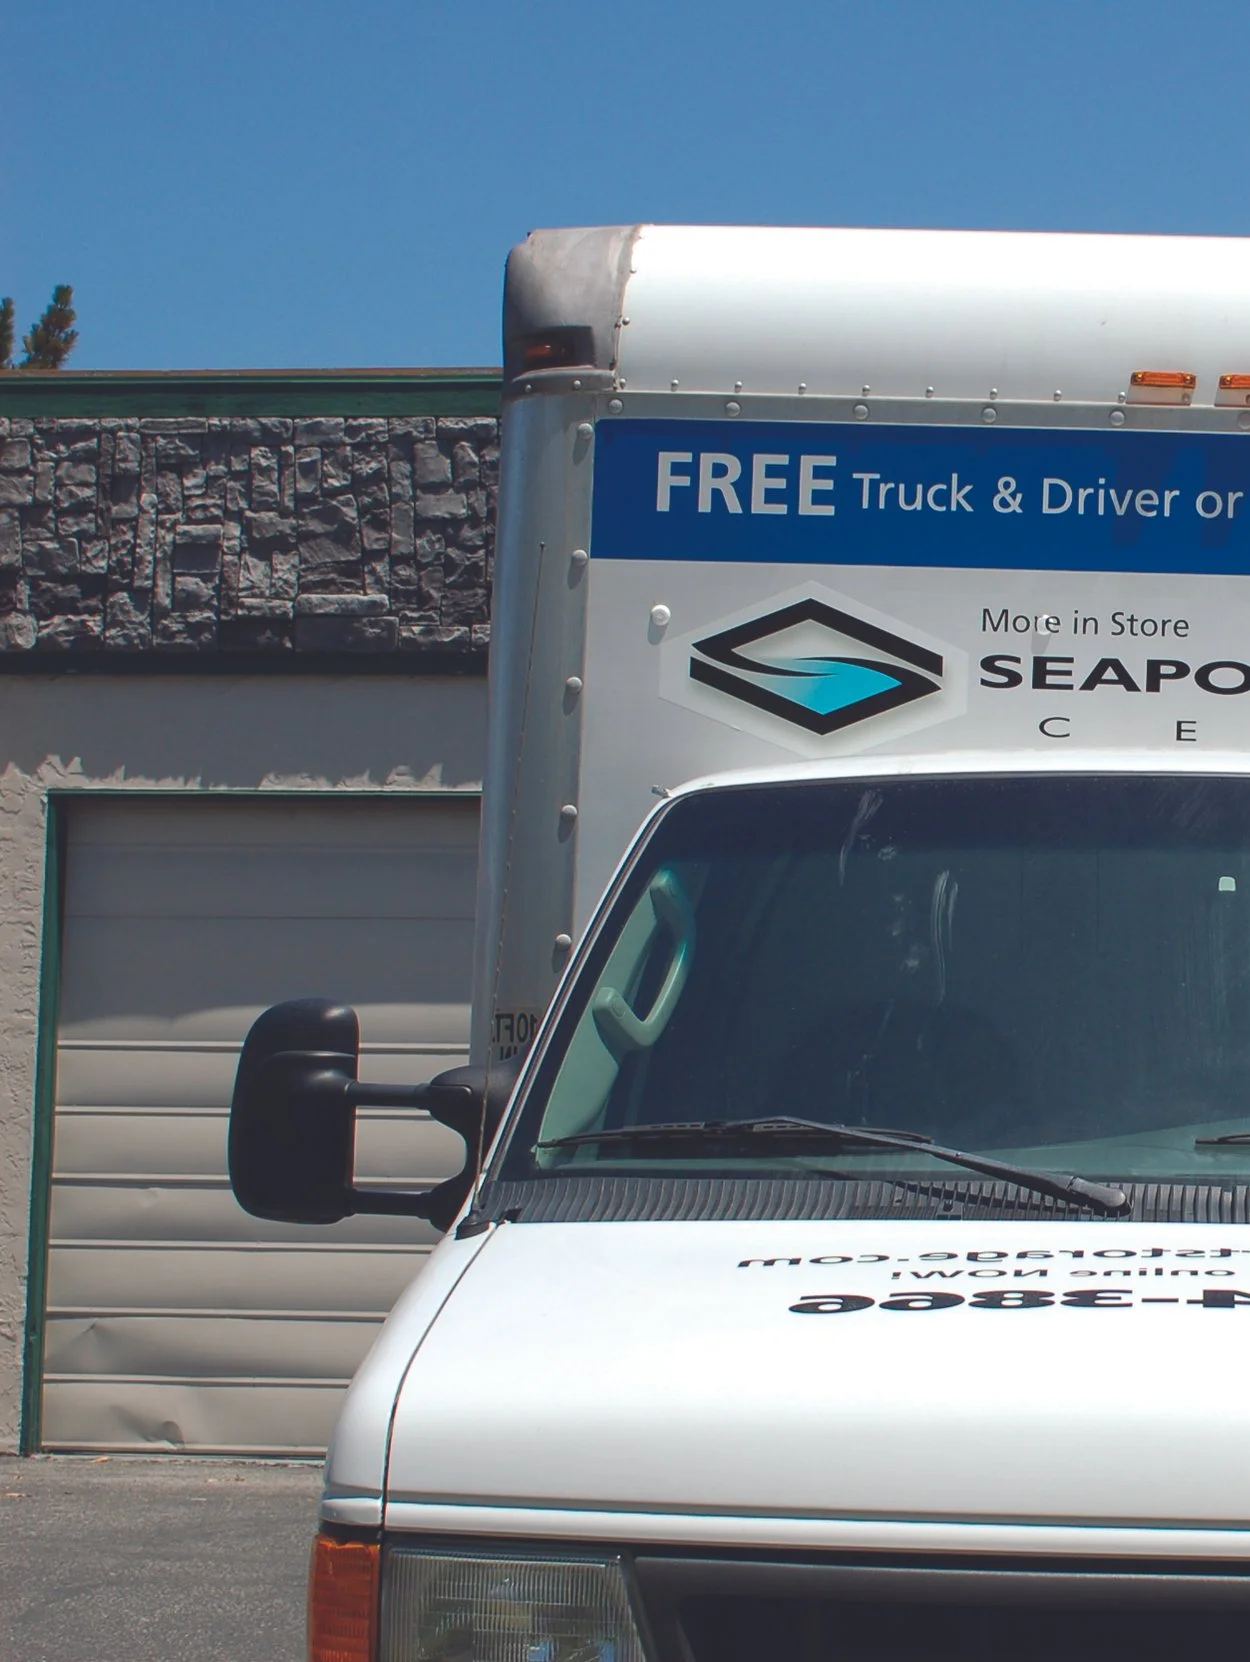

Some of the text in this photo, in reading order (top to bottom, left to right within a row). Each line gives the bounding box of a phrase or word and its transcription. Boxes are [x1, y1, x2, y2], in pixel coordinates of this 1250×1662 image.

[656, 451, 837, 516] FREE
[852, 472, 974, 512] Truck
[992, 476, 1023, 514] &
[1042, 477, 1180, 517] Driver
[1195, 490, 1244, 519] or
[982, 608, 1190, 638] More in Store
